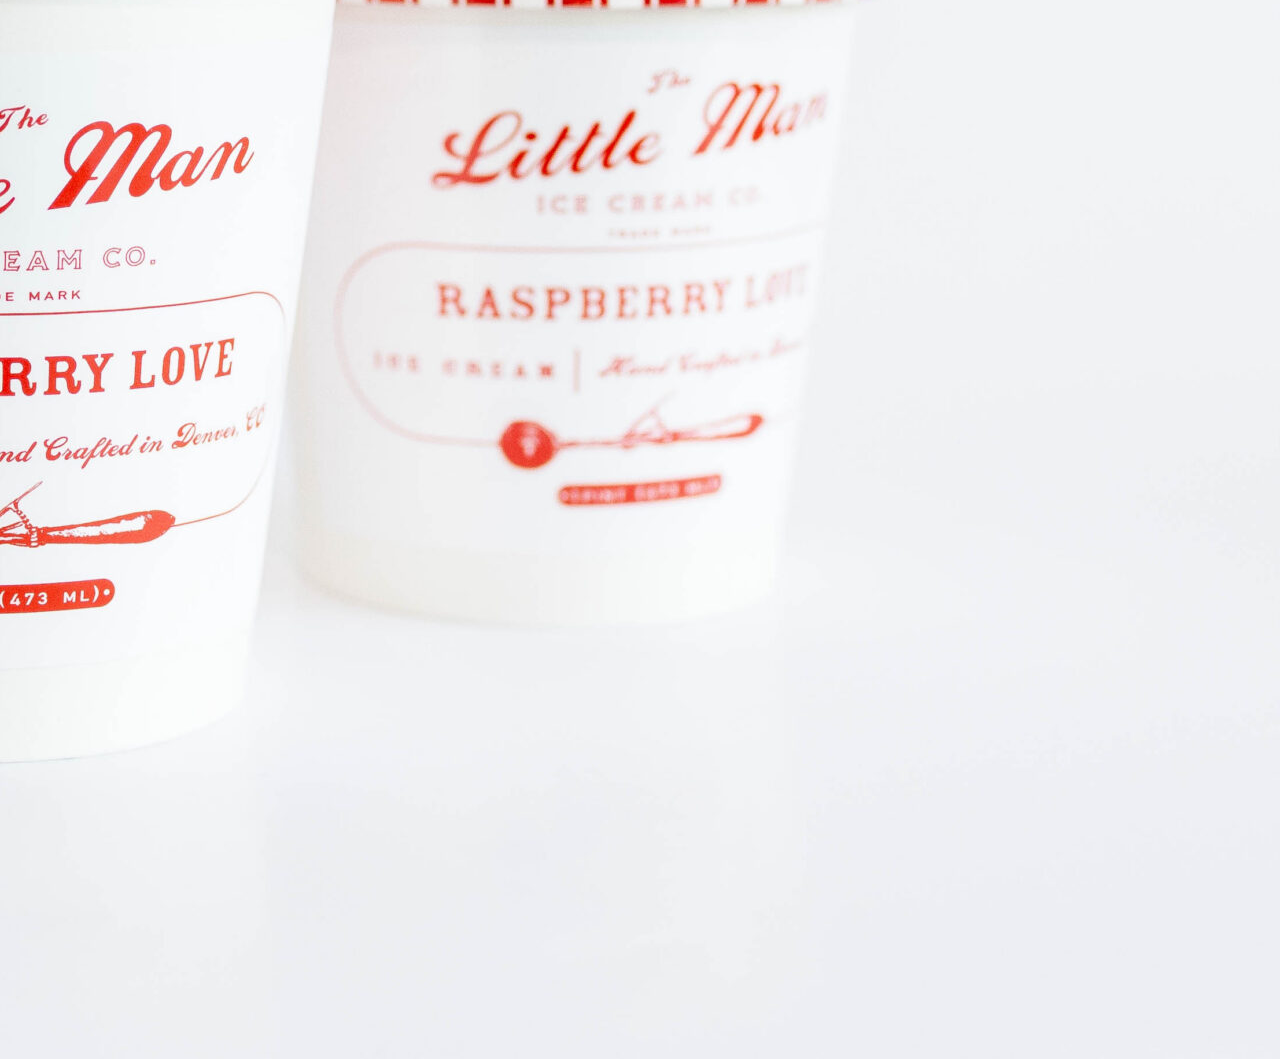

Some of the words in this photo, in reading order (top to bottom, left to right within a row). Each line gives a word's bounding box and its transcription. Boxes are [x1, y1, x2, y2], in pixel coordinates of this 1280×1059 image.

[431, 110, 664, 190] Little
[693, 82, 827, 156] Man
[47, 121, 254, 211] Man
[537, 194, 588, 215] ICE
[607, 190, 714, 214] CREAM
[102, 245, 157, 269] CO.
[29, 290, 82, 301] MARK
[436, 279, 731, 322] RASPBERRY
[131, 338, 235, 390] LOVE
[44, 435, 138, 469] Crafted
[139, 433, 163, 453] in
[62, 585, 100, 604] ML)
